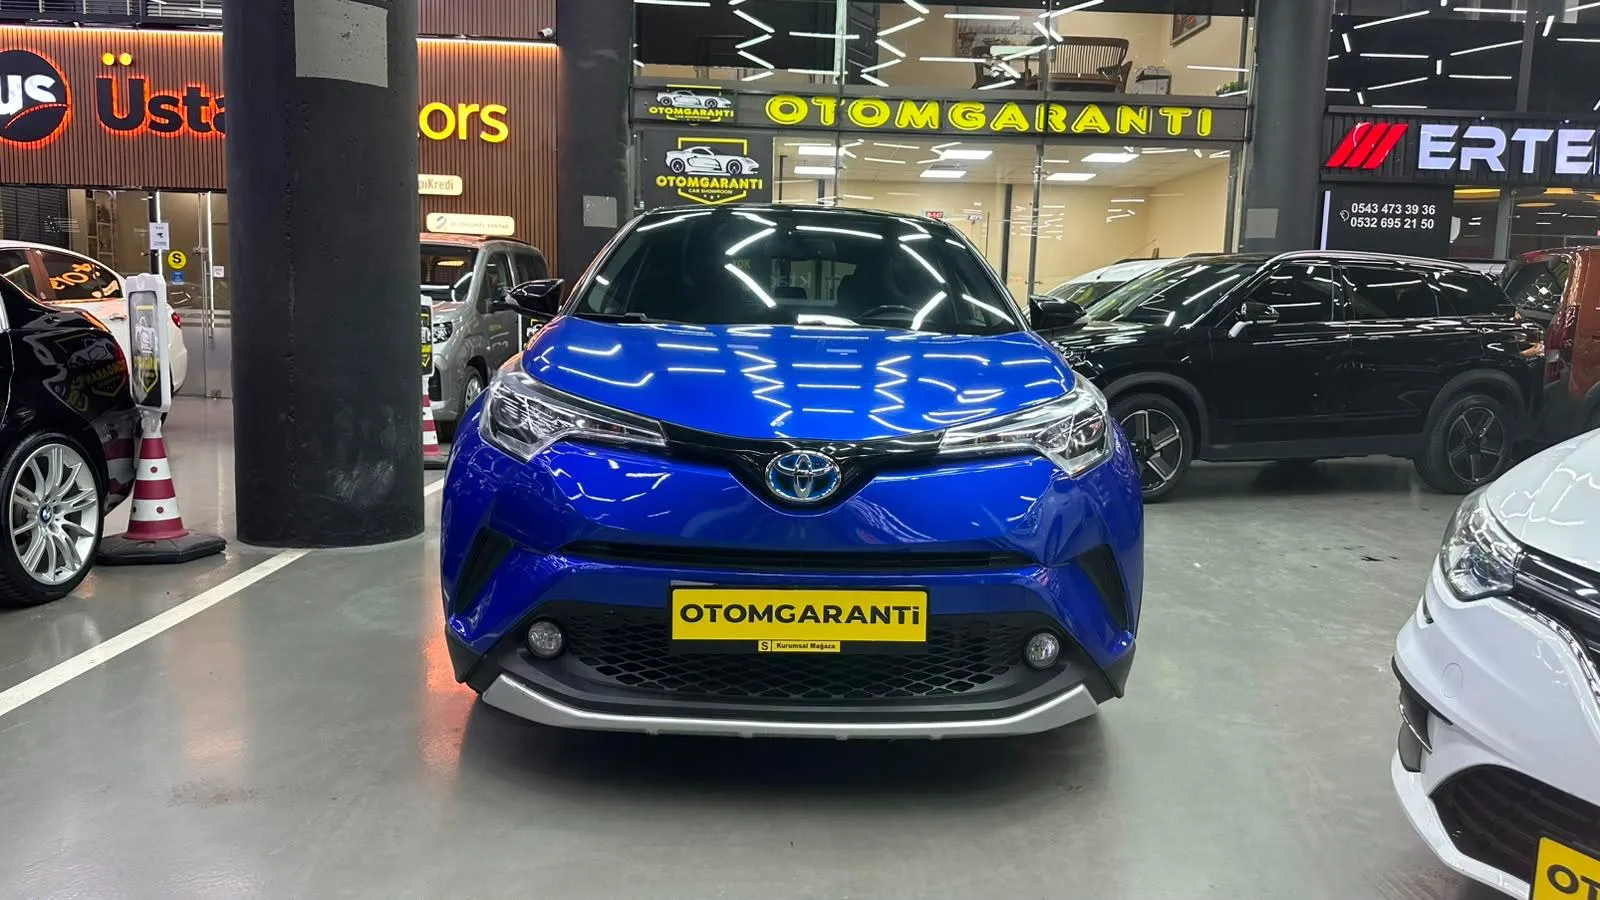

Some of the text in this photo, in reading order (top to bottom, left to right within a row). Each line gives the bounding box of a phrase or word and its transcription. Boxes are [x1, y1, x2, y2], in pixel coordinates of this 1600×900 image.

[649, 106, 734, 118] OTOMGARANTI
[765, 94, 1213, 137] OTOMGARANTI
[418, 101, 509, 143] ors
[1418, 124, 1600, 174] ERTE
[656, 175, 763, 190] OTOMGARANTI
[1351, 203, 1436, 216] 0543 473 39 36
[1350, 217, 1435, 230] 0532 695 21 50
[172, 253, 182, 264] S
[761, 641, 769, 651] S
